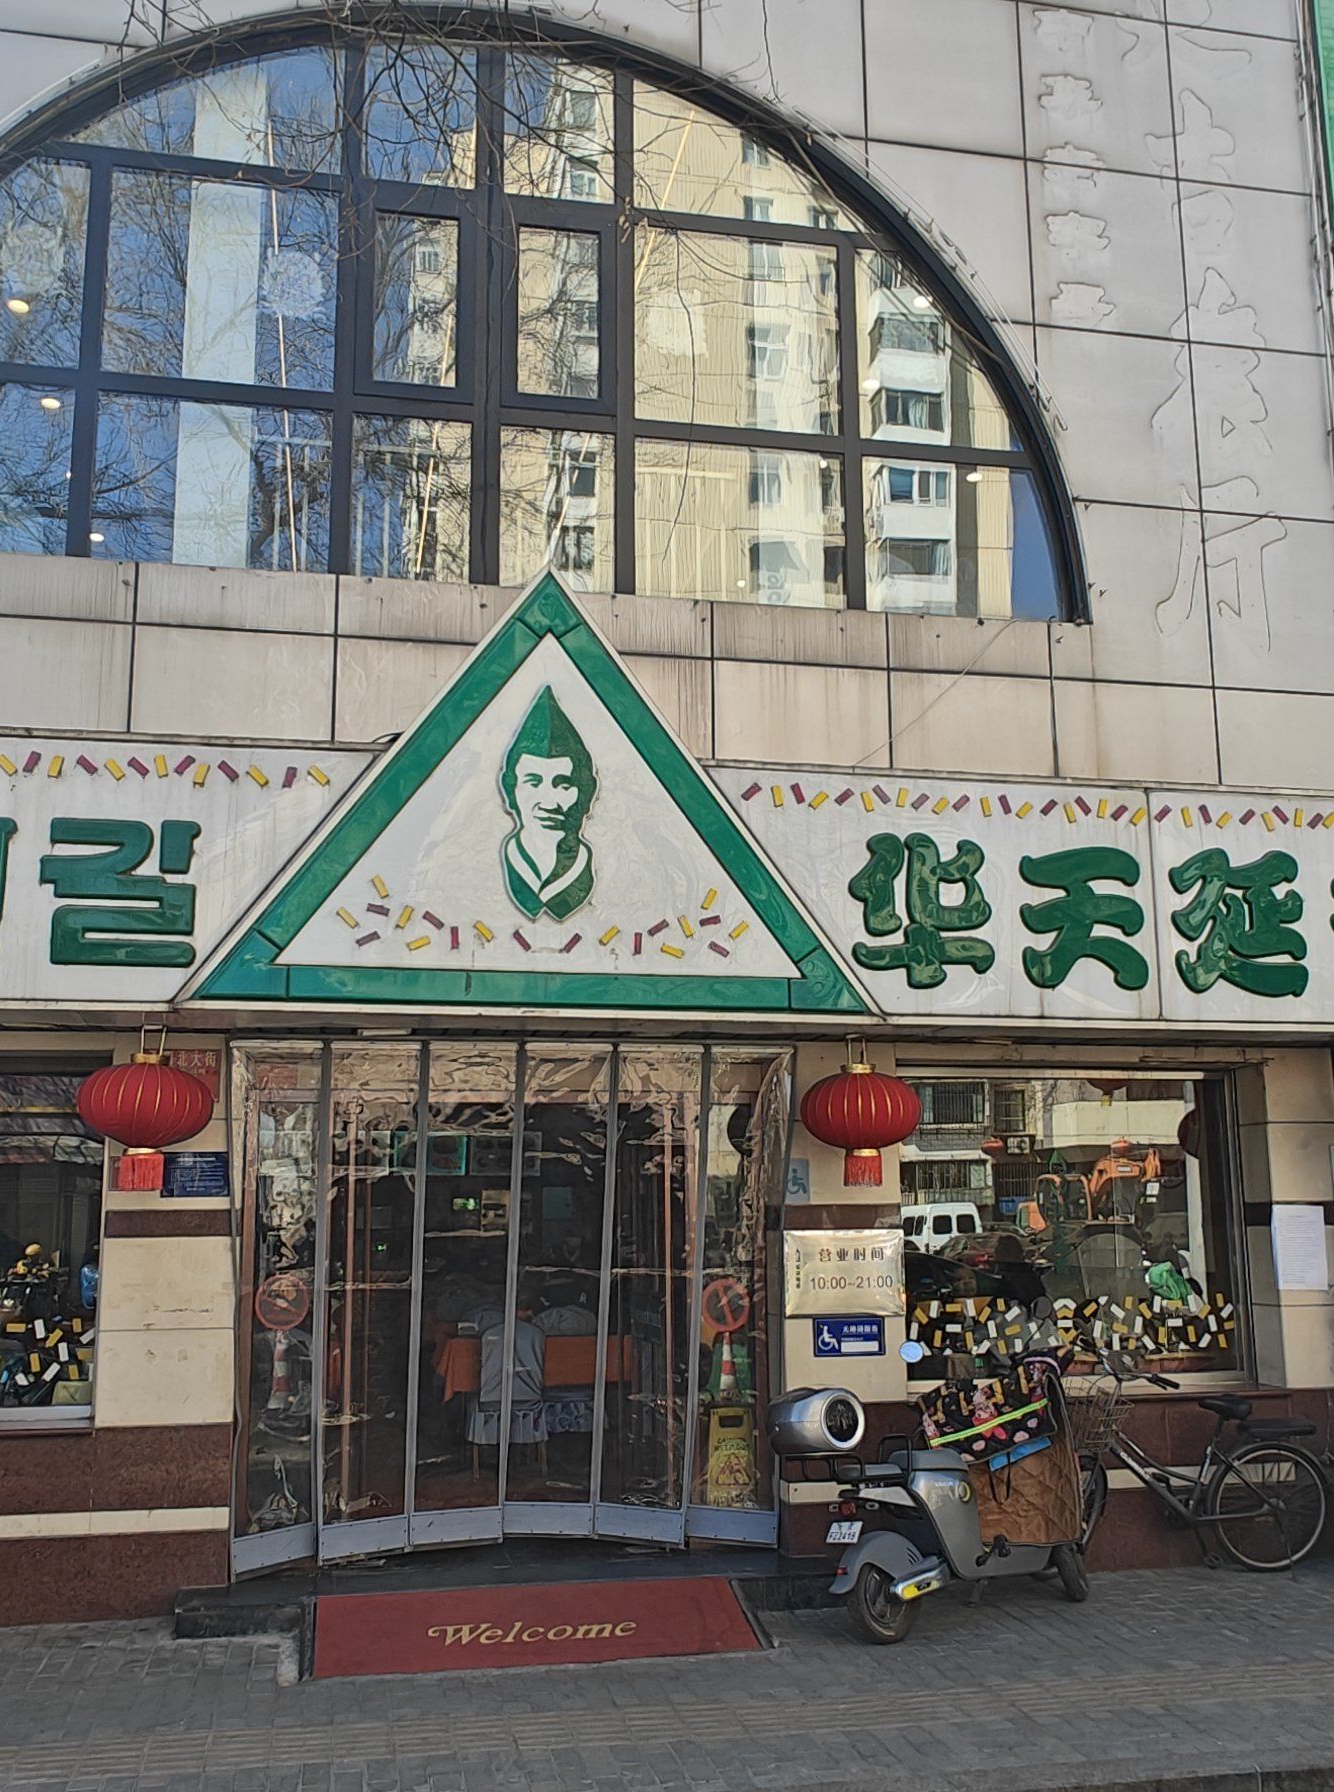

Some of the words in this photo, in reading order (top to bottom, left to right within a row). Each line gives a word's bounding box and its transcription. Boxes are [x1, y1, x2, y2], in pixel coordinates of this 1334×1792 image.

[818, 1247, 884, 1262] 营业时间
[427, 1620, 637, 1647] Welcome
